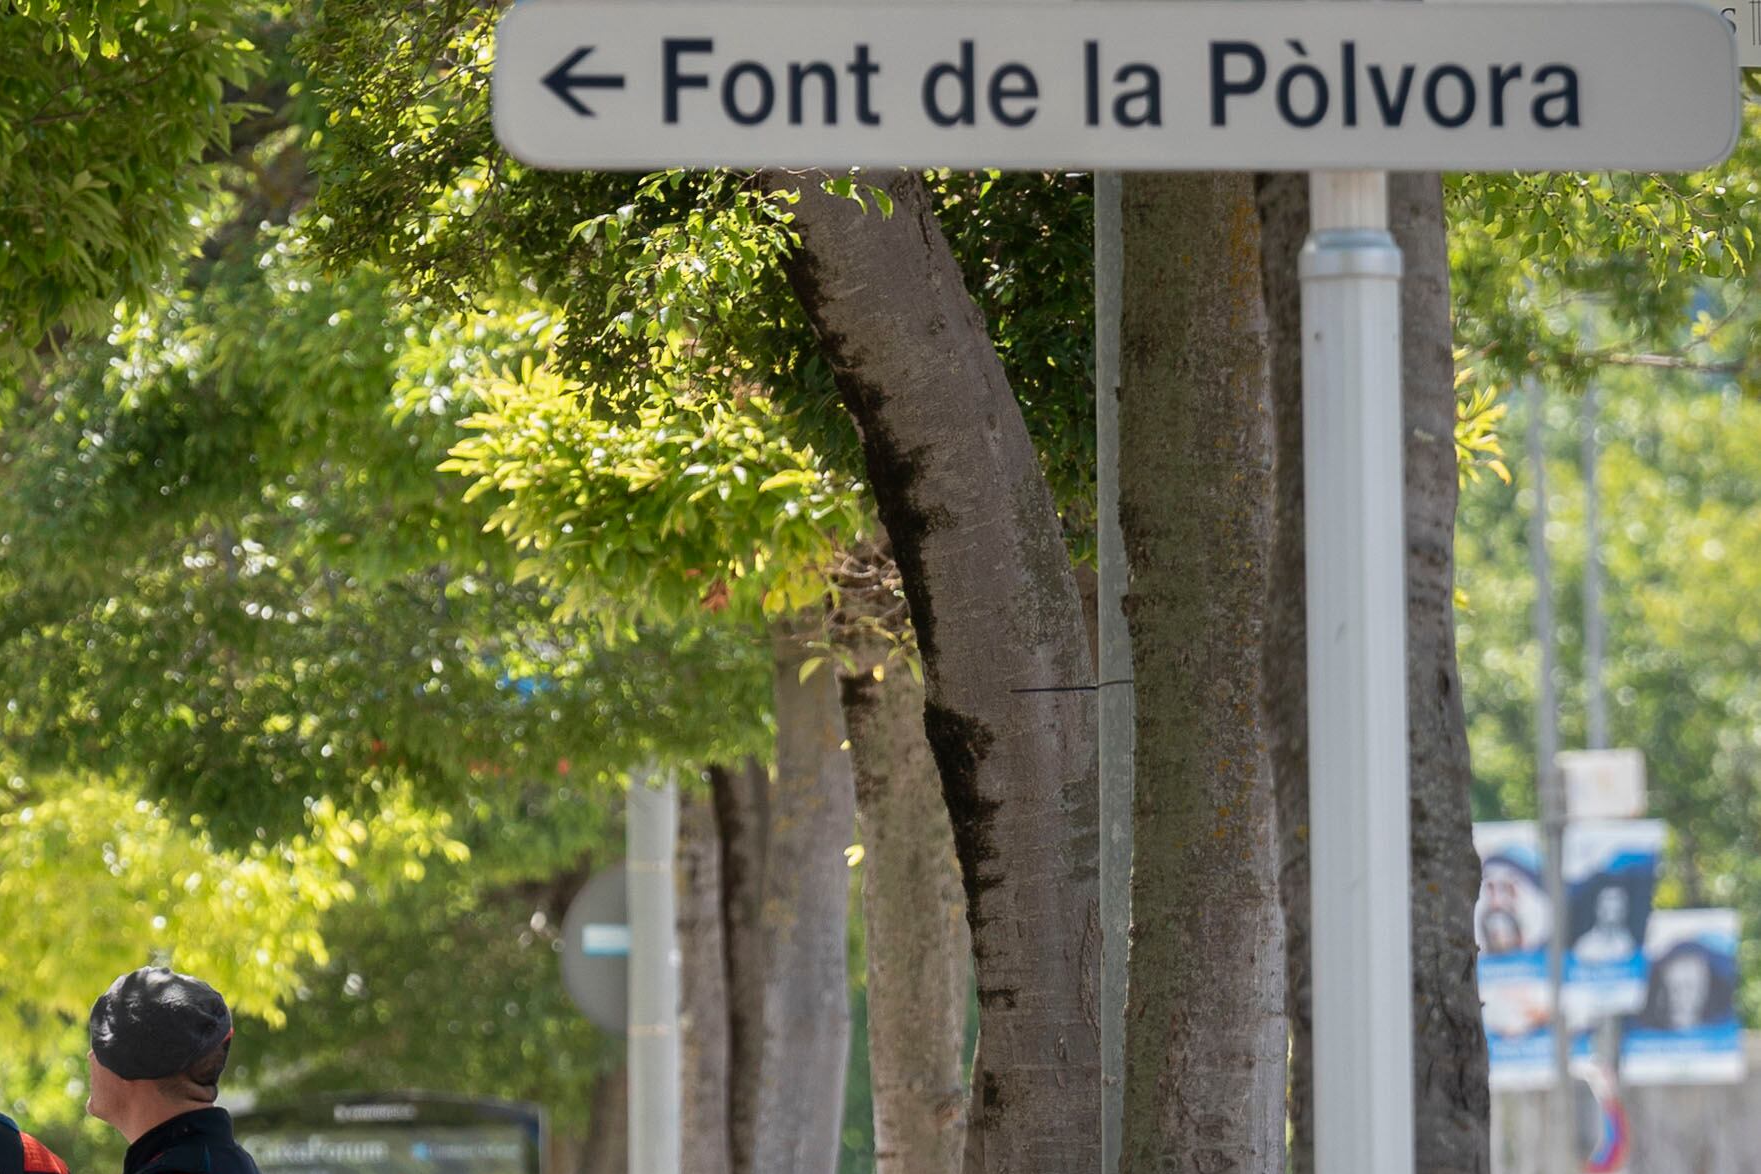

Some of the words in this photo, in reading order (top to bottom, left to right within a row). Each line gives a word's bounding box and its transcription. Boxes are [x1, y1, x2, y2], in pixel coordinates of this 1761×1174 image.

[661, 38, 881, 127] Font
[921, 39, 1040, 128] de
[1083, 40, 1163, 128] la
[1209, 39, 1582, 128] Pòlvora
